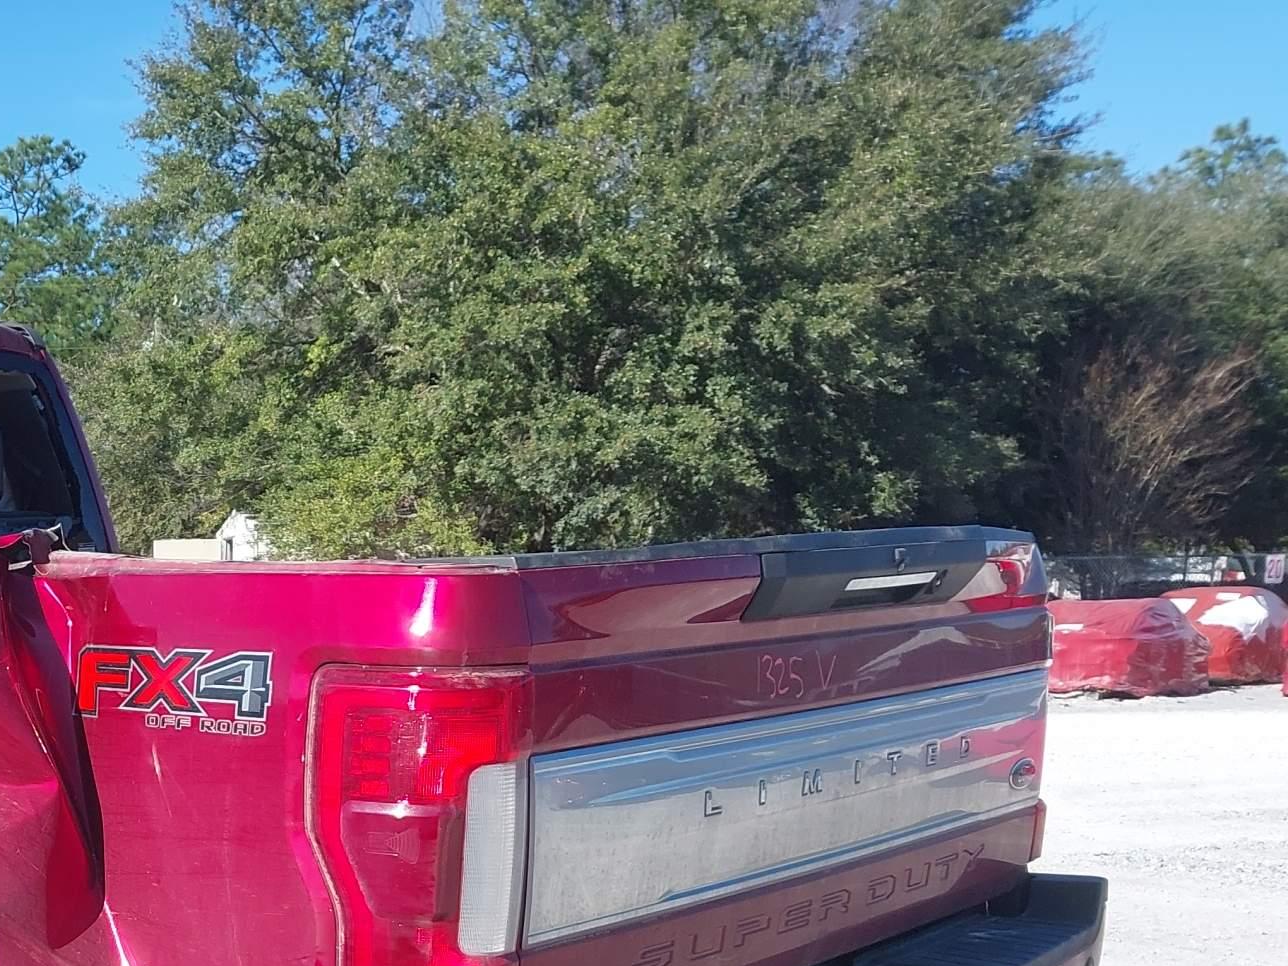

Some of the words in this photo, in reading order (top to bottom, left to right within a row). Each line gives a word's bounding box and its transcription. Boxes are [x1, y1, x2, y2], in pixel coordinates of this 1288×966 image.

[74, 645, 272, 721] FX4
[756, 653, 805, 699] 1325
[144, 714, 191, 730] OFF
[200, 719, 267, 736] ROAD
[703, 735, 971, 818] LIMITED
[866, 843, 985, 905] DUTY
